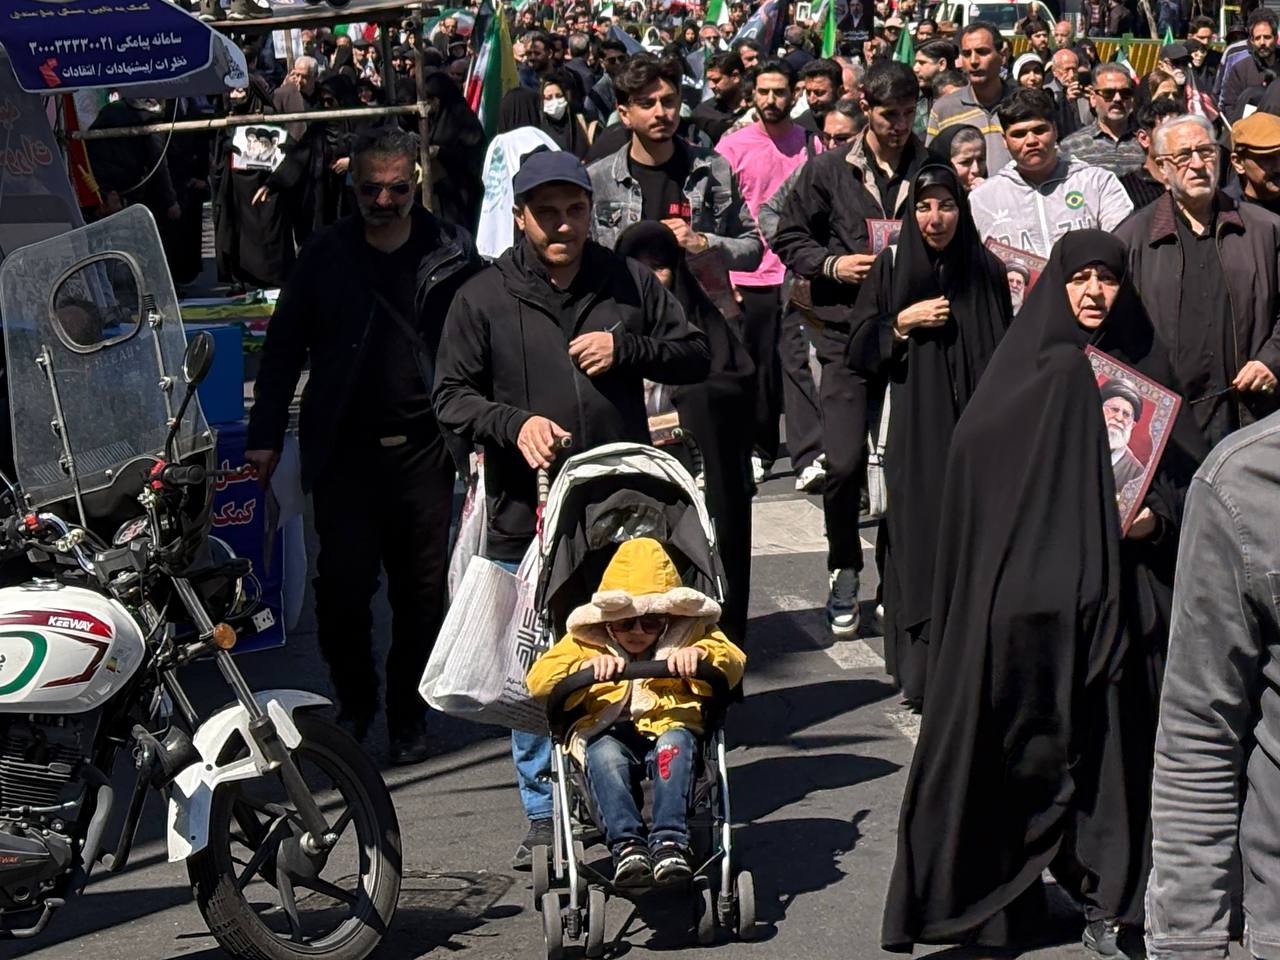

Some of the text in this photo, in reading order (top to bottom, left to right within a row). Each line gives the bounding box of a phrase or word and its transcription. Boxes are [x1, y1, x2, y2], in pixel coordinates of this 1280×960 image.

[116, 35, 150, 54] پیامکی
[152, 31, 182, 46] سامانه
[62, 64, 97, 78] انتقادات
[154, 56, 188, 72] نظرات
[211, 498, 257, 528] کمک
